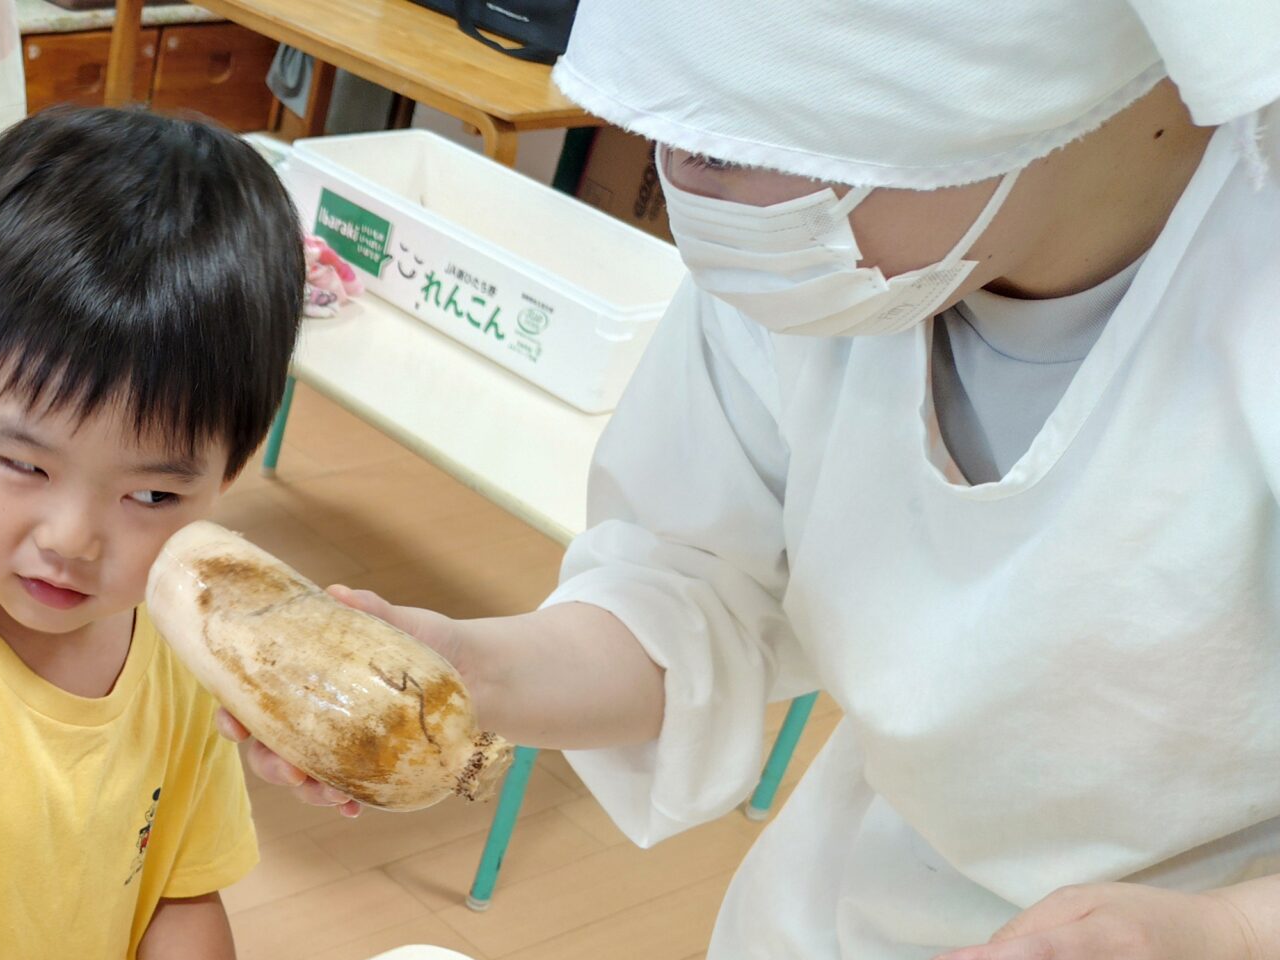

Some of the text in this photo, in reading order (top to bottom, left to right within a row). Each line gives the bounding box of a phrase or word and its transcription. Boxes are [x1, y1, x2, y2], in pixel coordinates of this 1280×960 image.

[319, 206, 360, 242] Ibaraki
[421, 270, 504, 340] れんこん
